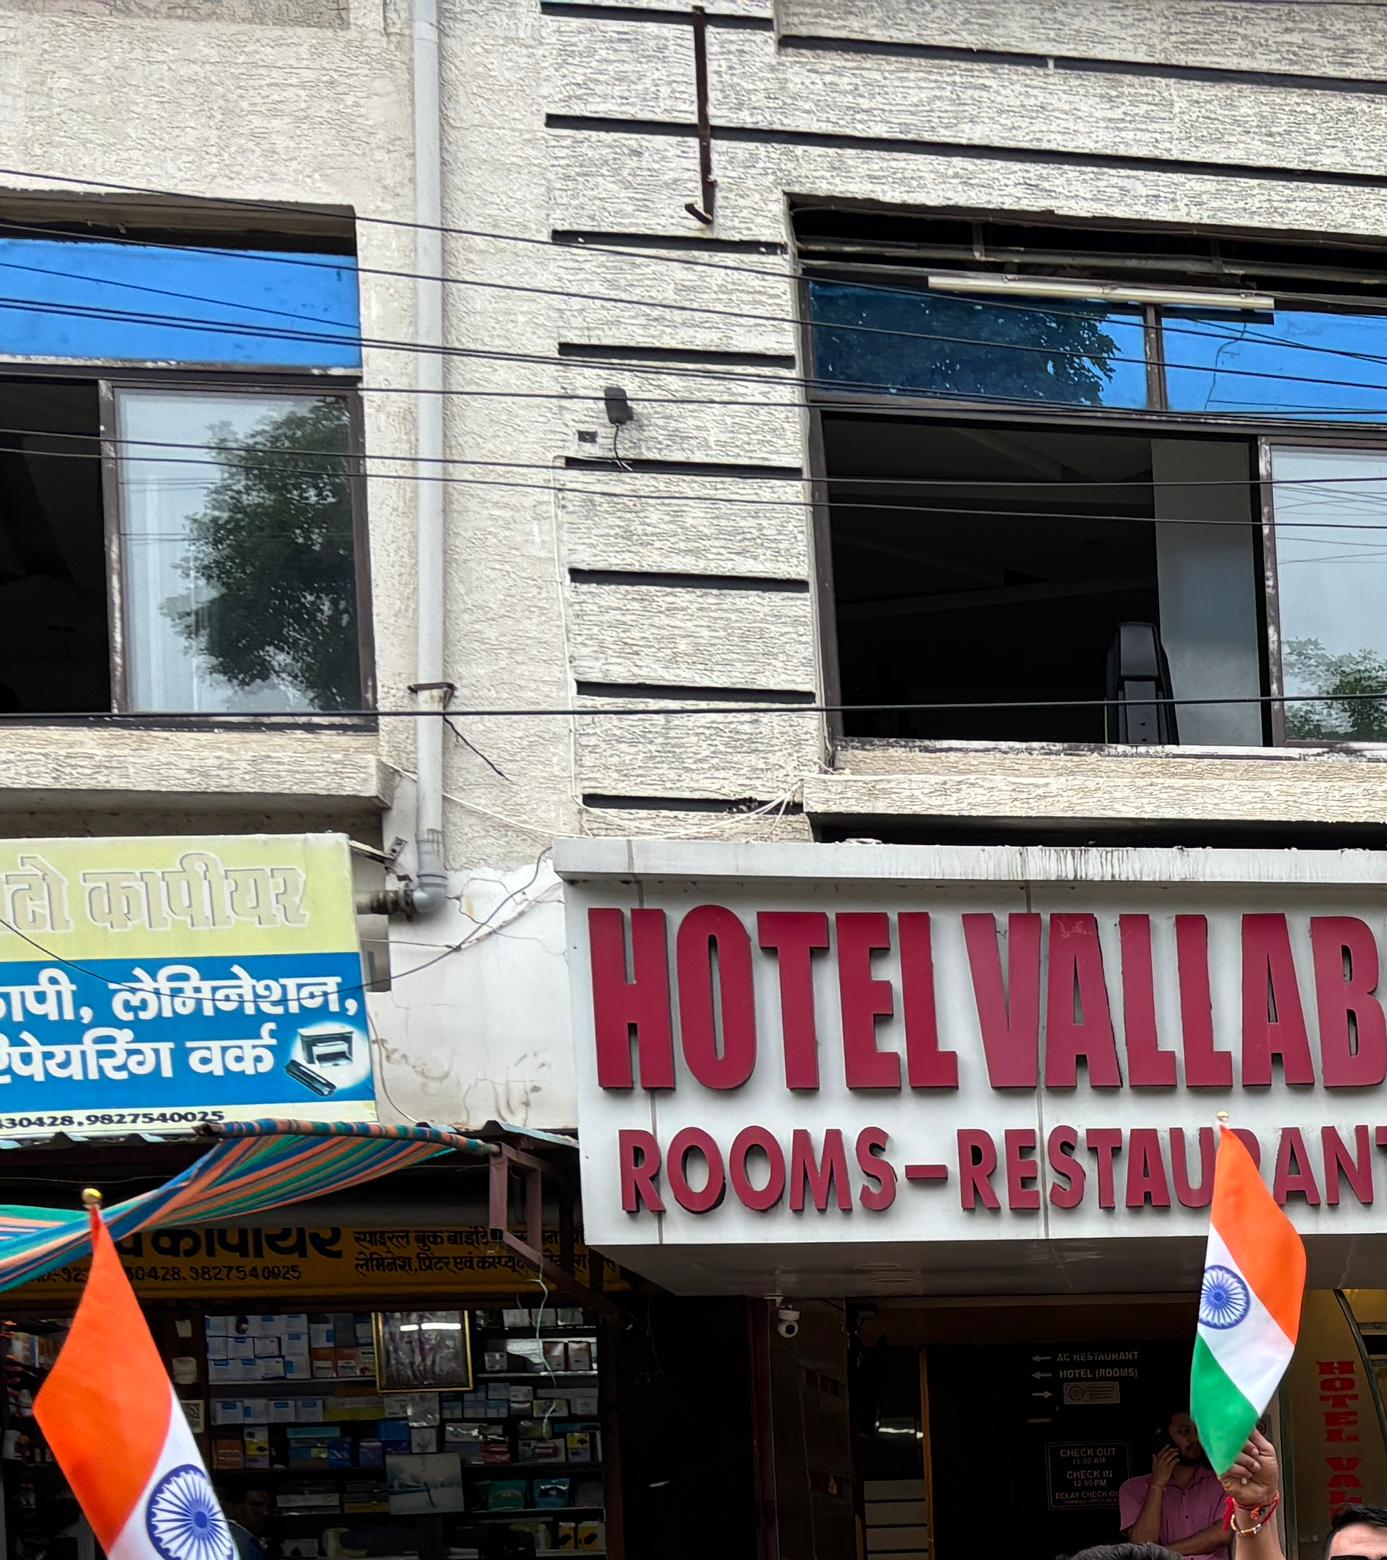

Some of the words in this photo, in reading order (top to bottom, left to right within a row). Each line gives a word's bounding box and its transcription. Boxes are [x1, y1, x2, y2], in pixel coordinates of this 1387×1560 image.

[588, 904, 958, 1090] HOTEL
[185, 1022, 276, 1077] वर्क
[1072, 1351, 1140, 1361] RESTAURANT
[1059, 1369, 1094, 1379] HOTEL
[1060, 1448, 1094, 1458] CHECK
[1096, 1447, 1116, 1457] OUT
[1066, 1470, 1101, 1480] CHECK
